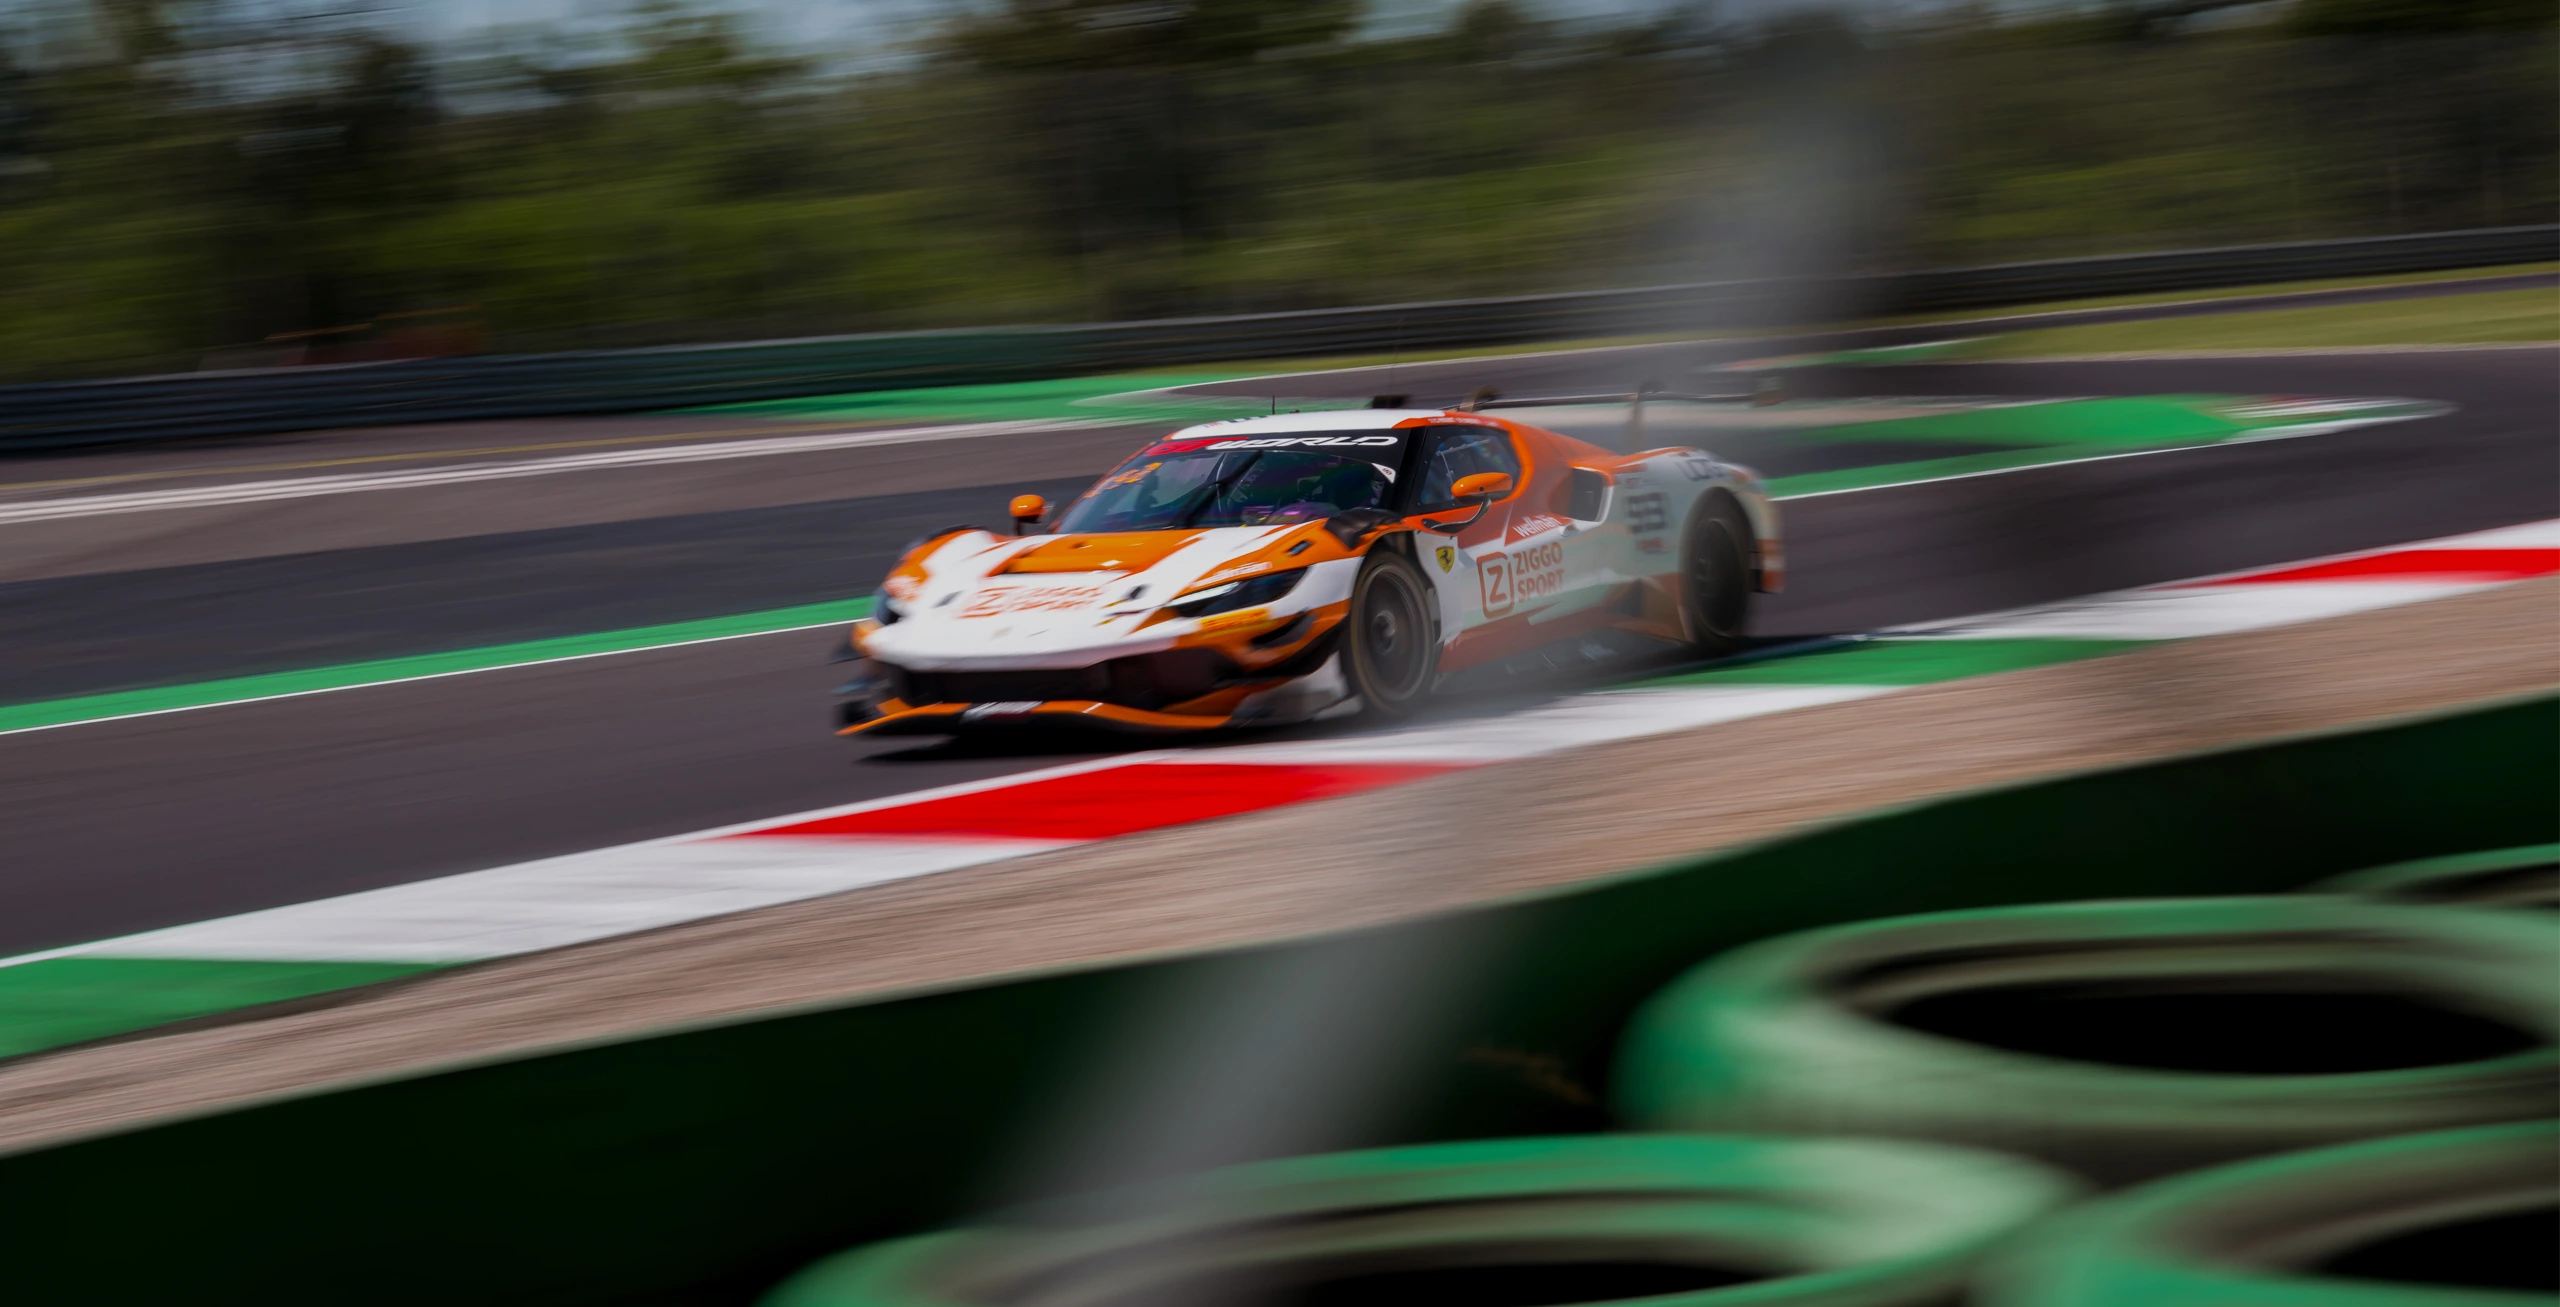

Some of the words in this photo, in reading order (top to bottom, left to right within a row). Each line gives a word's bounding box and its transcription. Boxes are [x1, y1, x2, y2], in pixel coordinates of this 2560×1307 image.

[1206, 436, 1398, 451] WORLD
[1513, 541, 1563, 576] ZIGGO
[1517, 569, 1565, 603] SPORT
